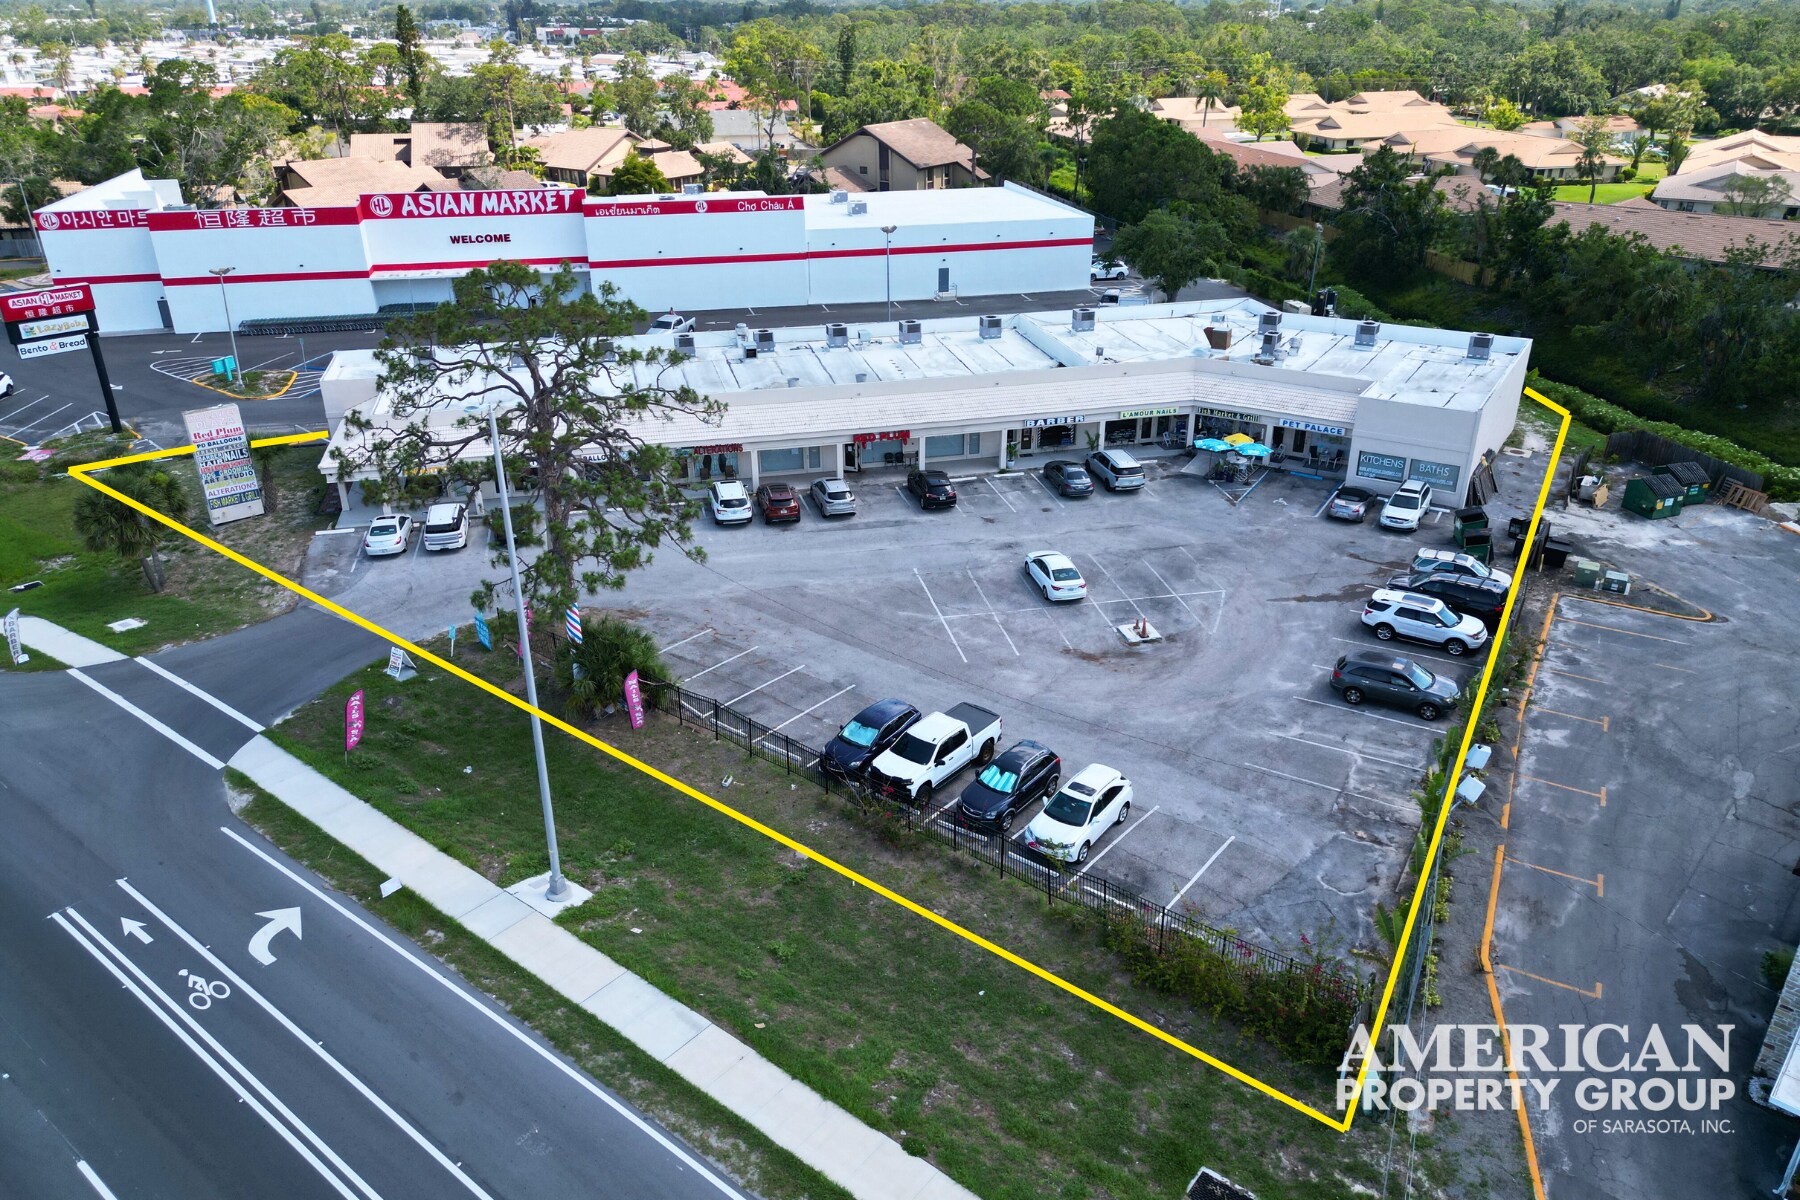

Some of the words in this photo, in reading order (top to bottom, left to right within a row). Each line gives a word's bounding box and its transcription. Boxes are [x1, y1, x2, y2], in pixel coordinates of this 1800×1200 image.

[401, 193, 475, 216] ASIAN
[481, 190, 574, 214] MARKET
[62, 210, 114, 228] 아시안
[194, 206, 316, 229] 恒隆超市
[450, 234, 511, 244] WELCOME
[11, 298, 38, 307] ASIAN
[54, 291, 81, 301] MARKET
[24, 304, 75, 318] 恒隆超市
[20, 345, 48, 355] Bento
[50, 342, 57, 351] &
[58, 338, 86, 348] Bread
[1213, 409, 1234, 418] Market
[1026, 415, 1084, 427] BARBER
[1282, 420, 1301, 429] PET
[1304, 424, 1343, 435] PALACE
[193, 430, 212, 439] Red
[215, 426, 241, 435] Plum
[853, 433, 876, 443] RED
[208, 436, 241, 446] BALLOONS
[223, 448, 248, 461] NAILS
[694, 443, 743, 454] ALTERATIONS
[199, 459, 224, 467] HAIR
[1360, 454, 1404, 468] KITCHENS
[220, 464, 252, 475] GROOMING
[223, 470, 253, 481] STUDIO
[1419, 463, 1450, 477] BATHS
[208, 481, 256, 497] ALTERATIONS
[8, 621, 19, 656] BARBER
